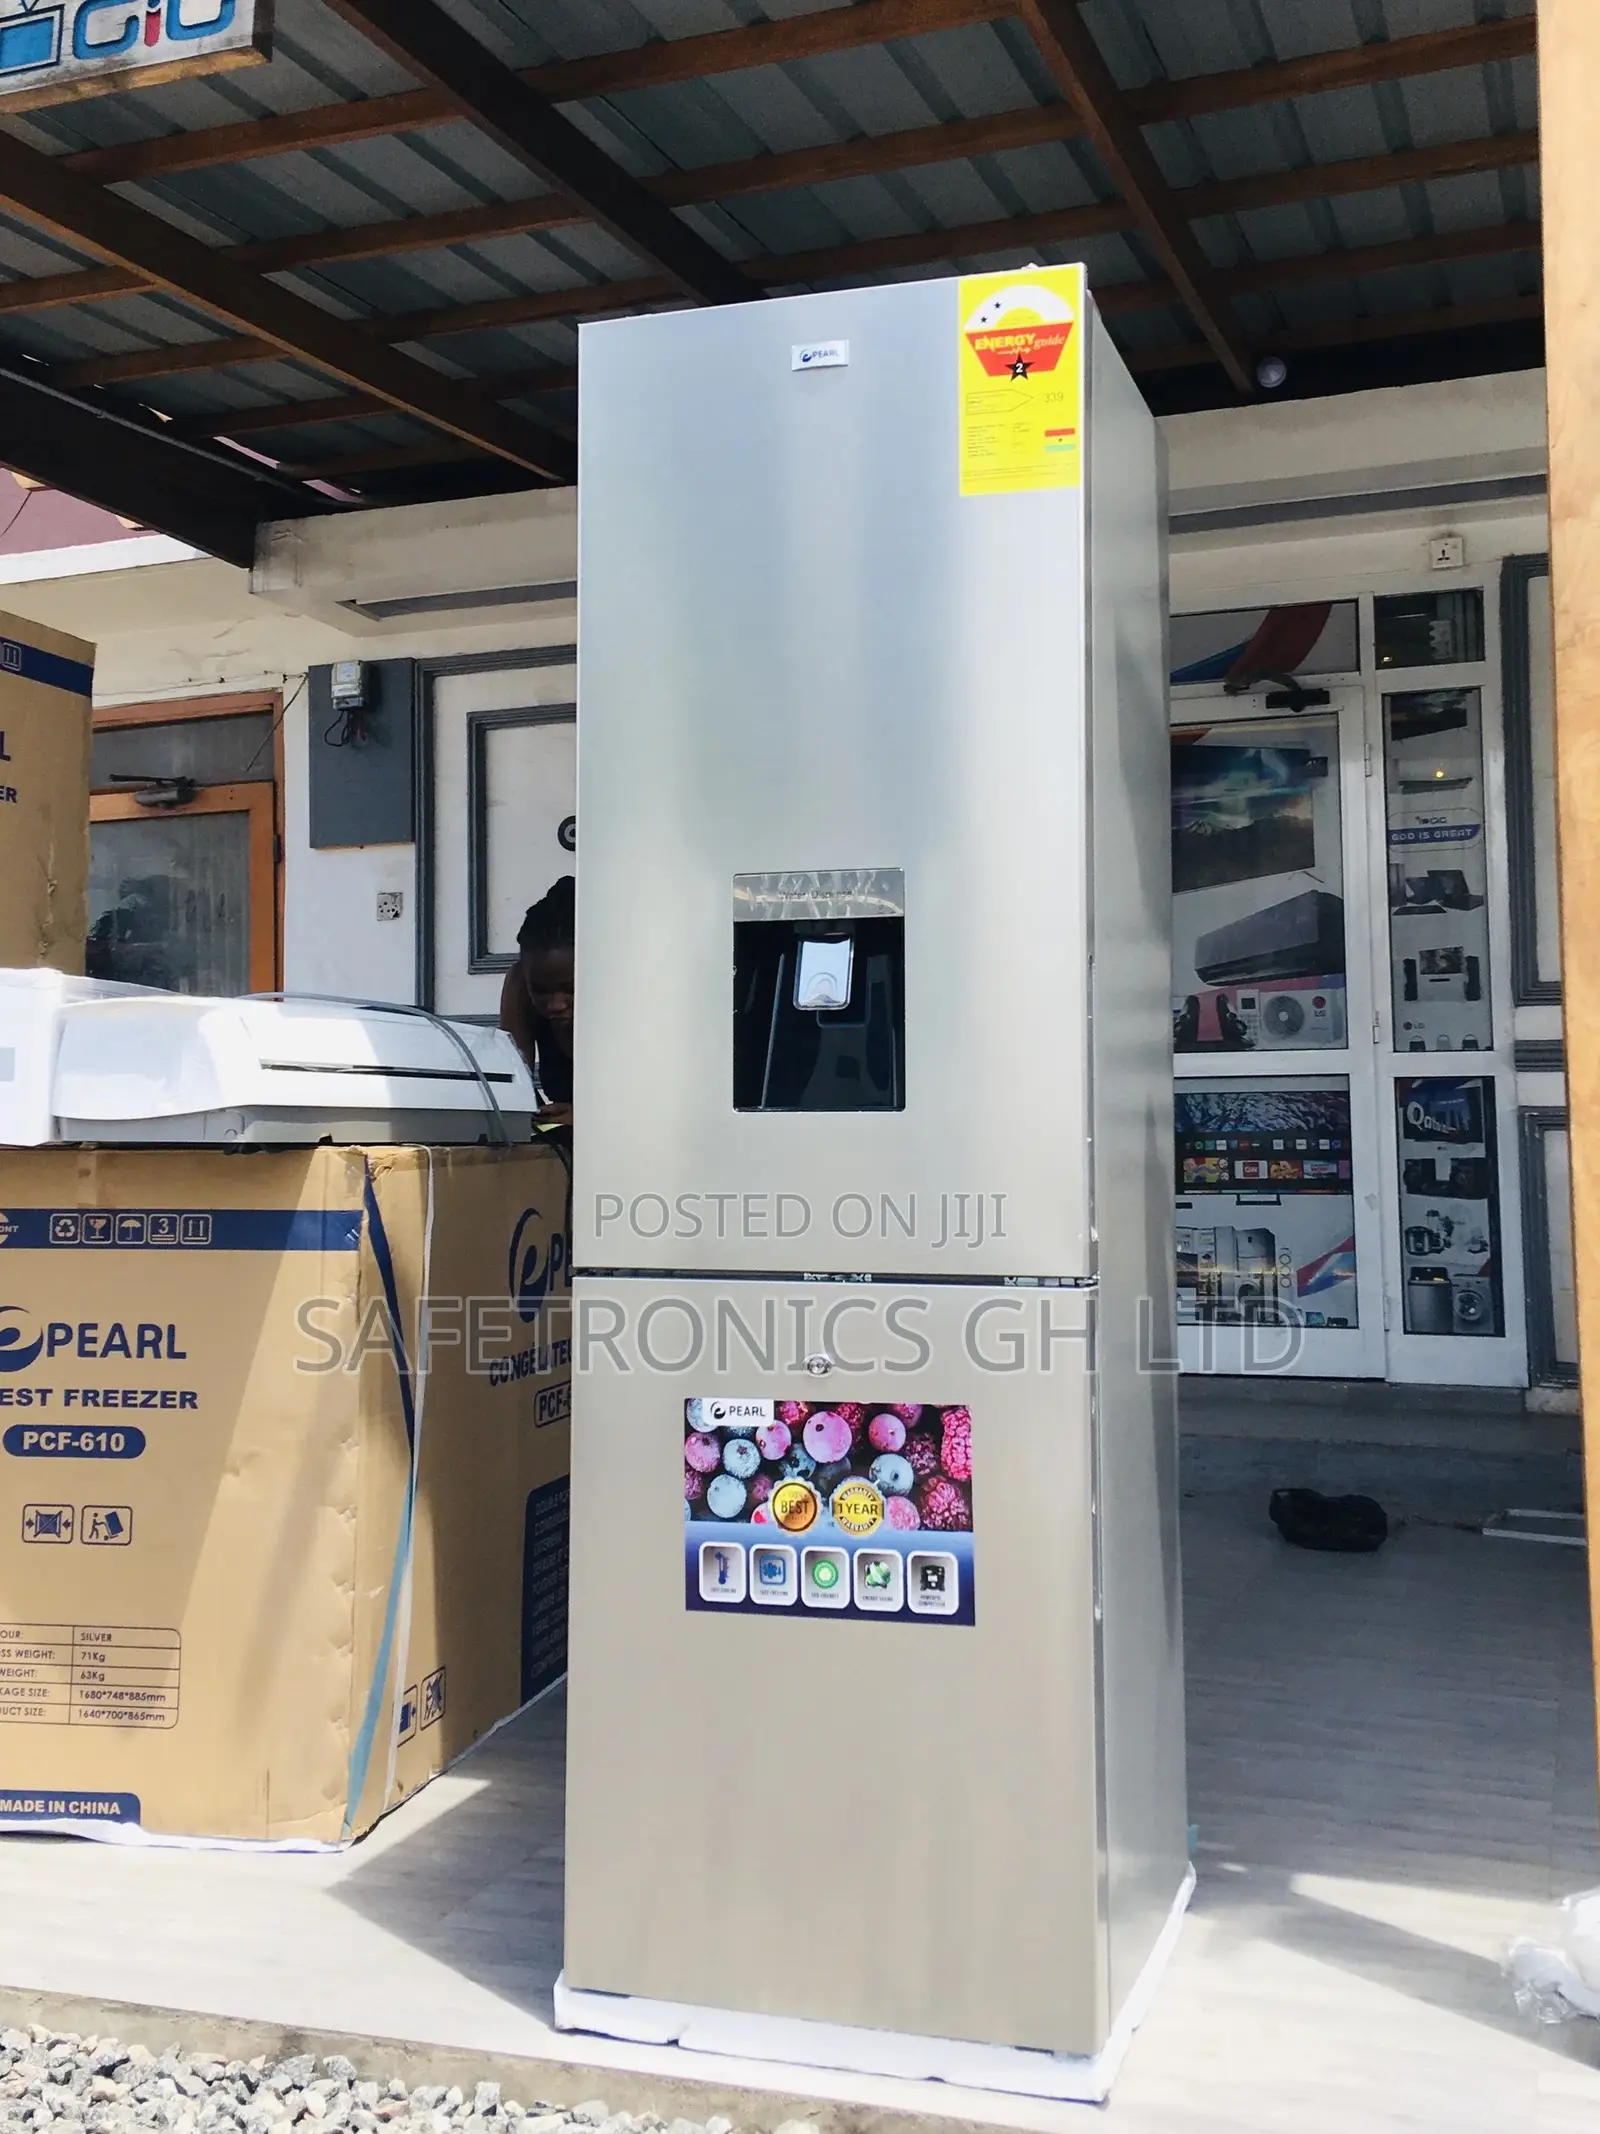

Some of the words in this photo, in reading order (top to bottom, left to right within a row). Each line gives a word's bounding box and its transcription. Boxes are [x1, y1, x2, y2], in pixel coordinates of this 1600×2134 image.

[974, 333, 1036, 352] ENERGY
[1033, 334, 1066, 350] guide
[812, 349, 839, 358] PEARL
[1015, 363, 1023, 373] 2
[1391, 832, 1416, 842] GOD
[1419, 831, 1430, 840] IS
[1433, 828, 1472, 839] GREAT
[1314, 1009, 1326, 1018] LG
[47, 1323, 187, 1359] PEARL
[64, 1389, 198, 1409] FREEZER
[729, 1406, 766, 1417] PEARL
[23, 1431, 125, 1452] PCF-610
[781, 1500, 809, 1514] BEST
[846, 1503, 878, 1515] YEAR
[80, 1632, 112, 1642] SILVER
[15, 1649, 55, 1660] WEIGHT:
[81, 1651, 105, 1662] 71Kg
[0, 1669, 38, 1678] WEIGHT:
[80, 1671, 105, 1681] 63Kg
[28, 1688, 50, 1697] SIZE:
[24, 1707, 46, 1717] SIZE:
[0, 1799, 45, 1812] MADE
[48, 1800, 65, 1813] IN
[69, 1801, 121, 1814] CHINA
